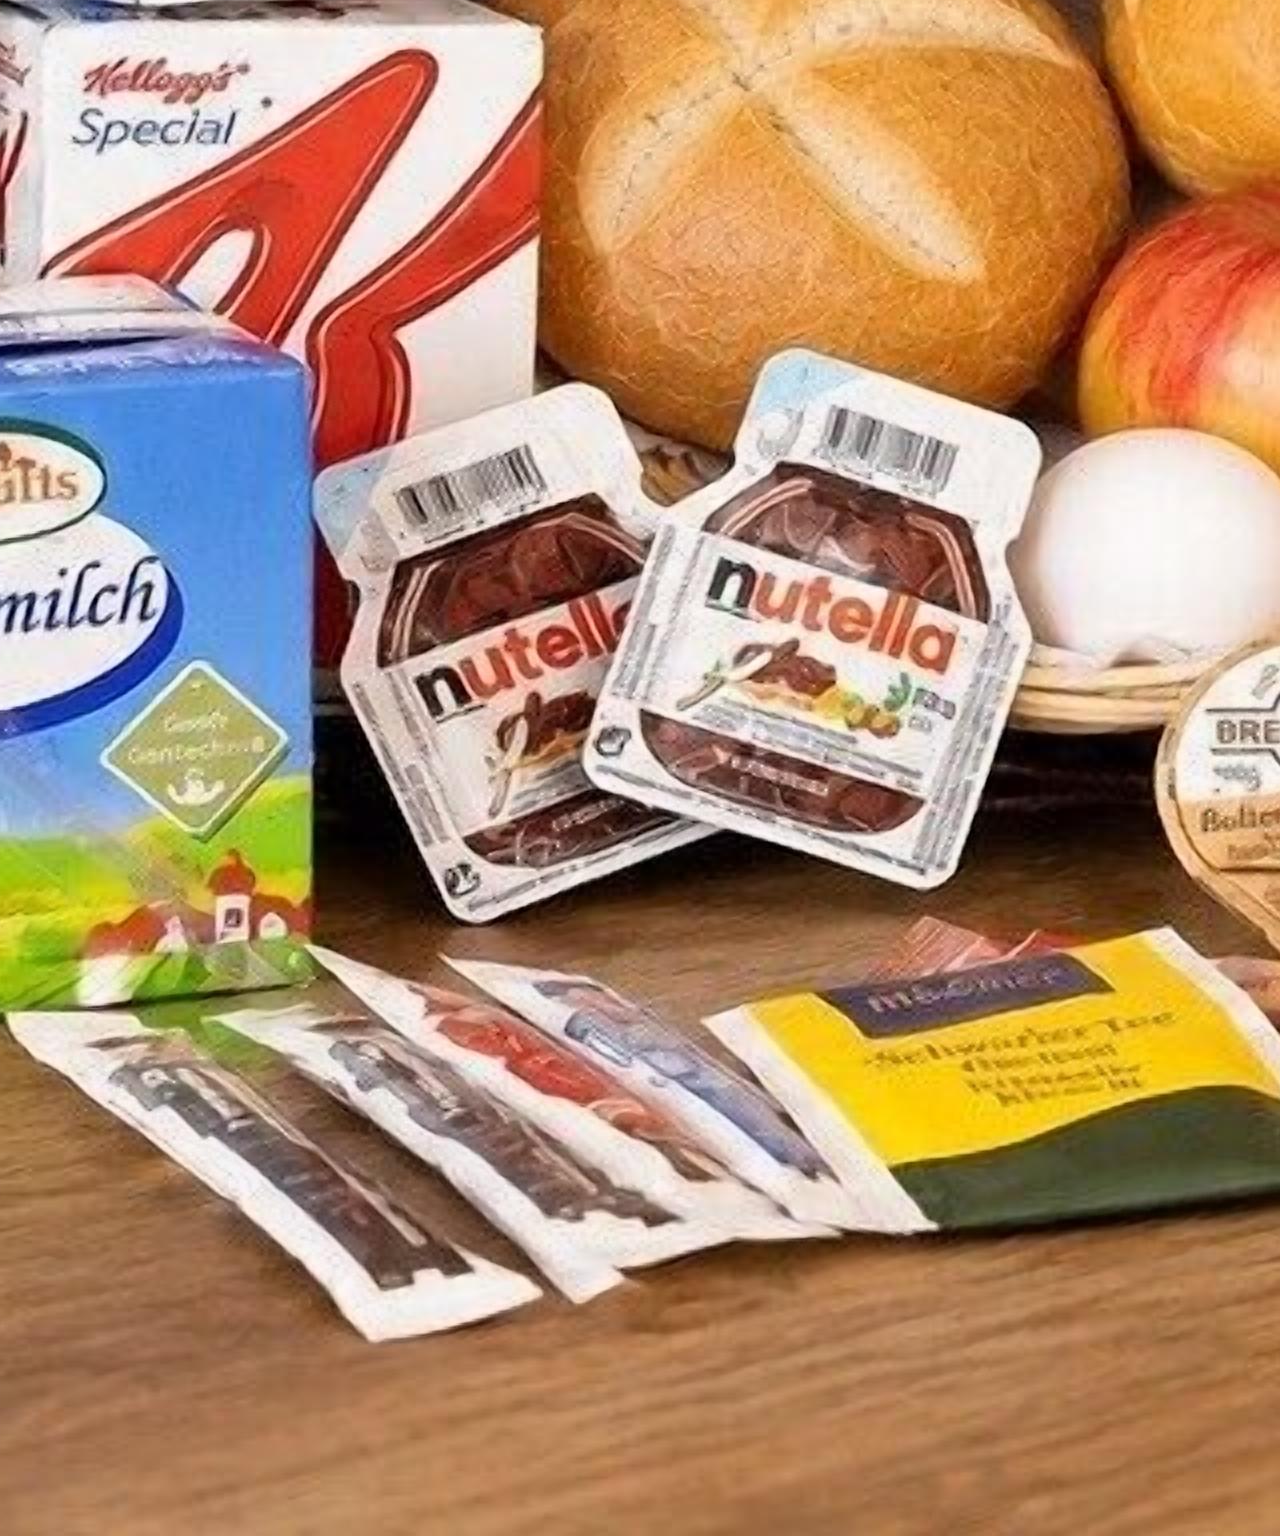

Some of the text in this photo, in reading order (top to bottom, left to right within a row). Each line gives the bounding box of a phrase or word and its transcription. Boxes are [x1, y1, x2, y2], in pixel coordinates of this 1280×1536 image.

[83, 56, 237, 105] Kellogg's
[72, 107, 239, 155] Special
[705, 556, 960, 676] nutella
